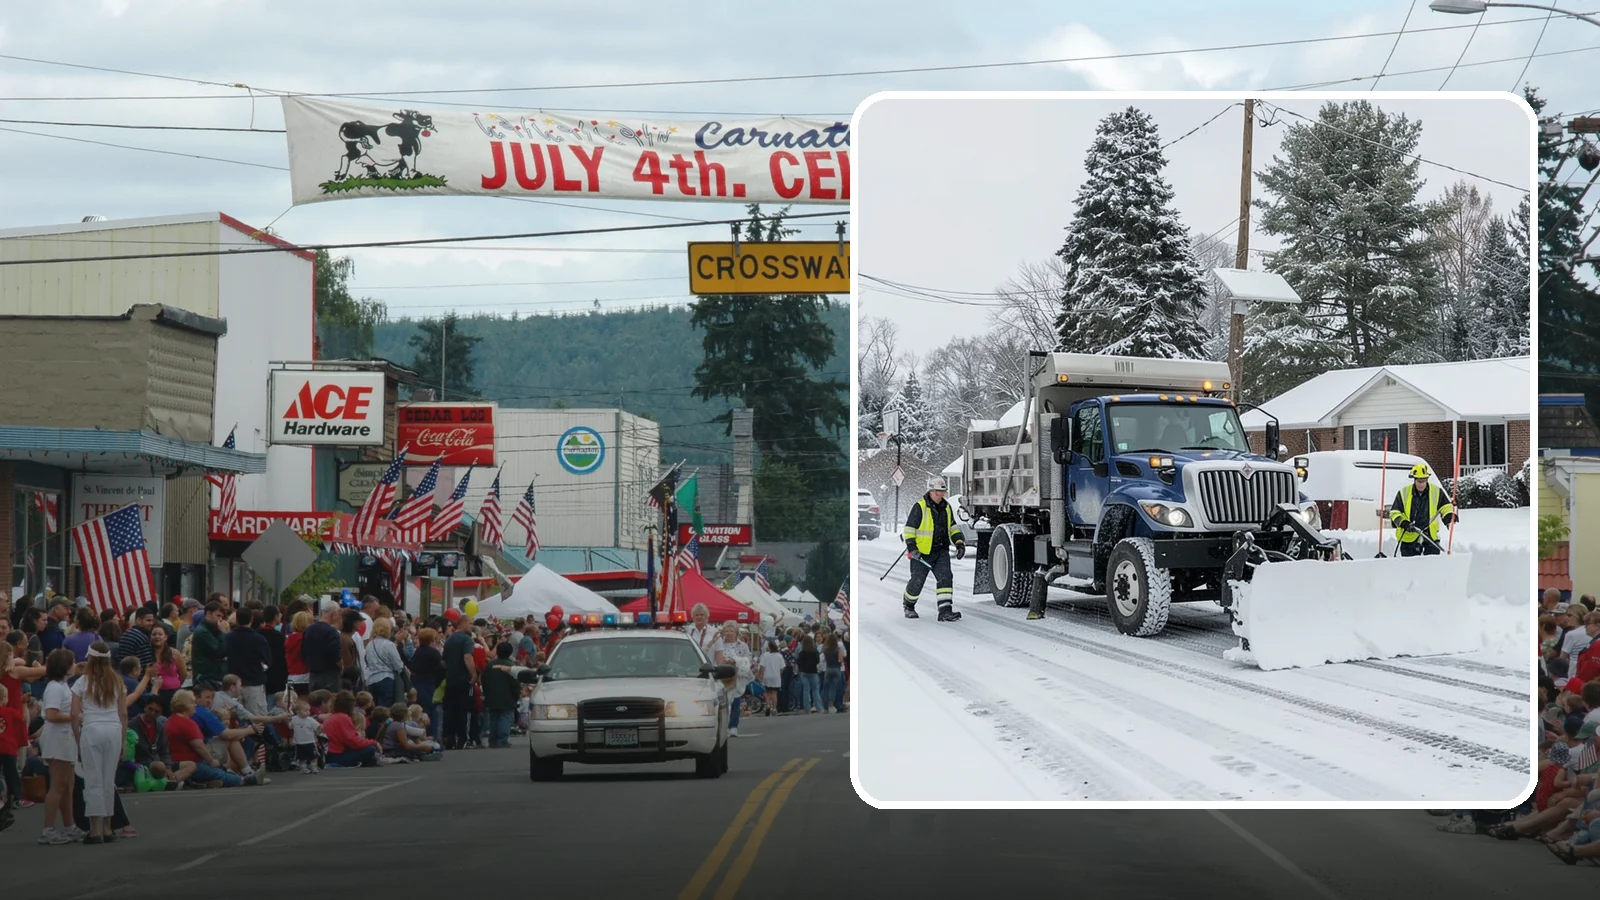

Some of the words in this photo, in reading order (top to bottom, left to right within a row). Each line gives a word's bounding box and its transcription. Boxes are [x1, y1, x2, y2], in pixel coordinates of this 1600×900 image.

[481, 141, 605, 192] JULY
[632, 150, 746, 197] 4th.
[696, 255, 850, 279] CROSSWA
[282, 380, 374, 420] ACE
[405, 409, 452, 422] CEDAR
[461, 409, 485, 422] LOG
[283, 421, 371, 437] Hardware
[416, 428, 477, 447] Coca-Cola
[353, 467, 384, 480] Simpl
[83, 485, 93, 494] St.
[95, 485, 125, 495] Vincent
[126, 486, 135, 495] de
[137, 486, 155, 495] Paul
[688, 526, 741, 535] CRNATION
[699, 535, 730, 543] GLASS
